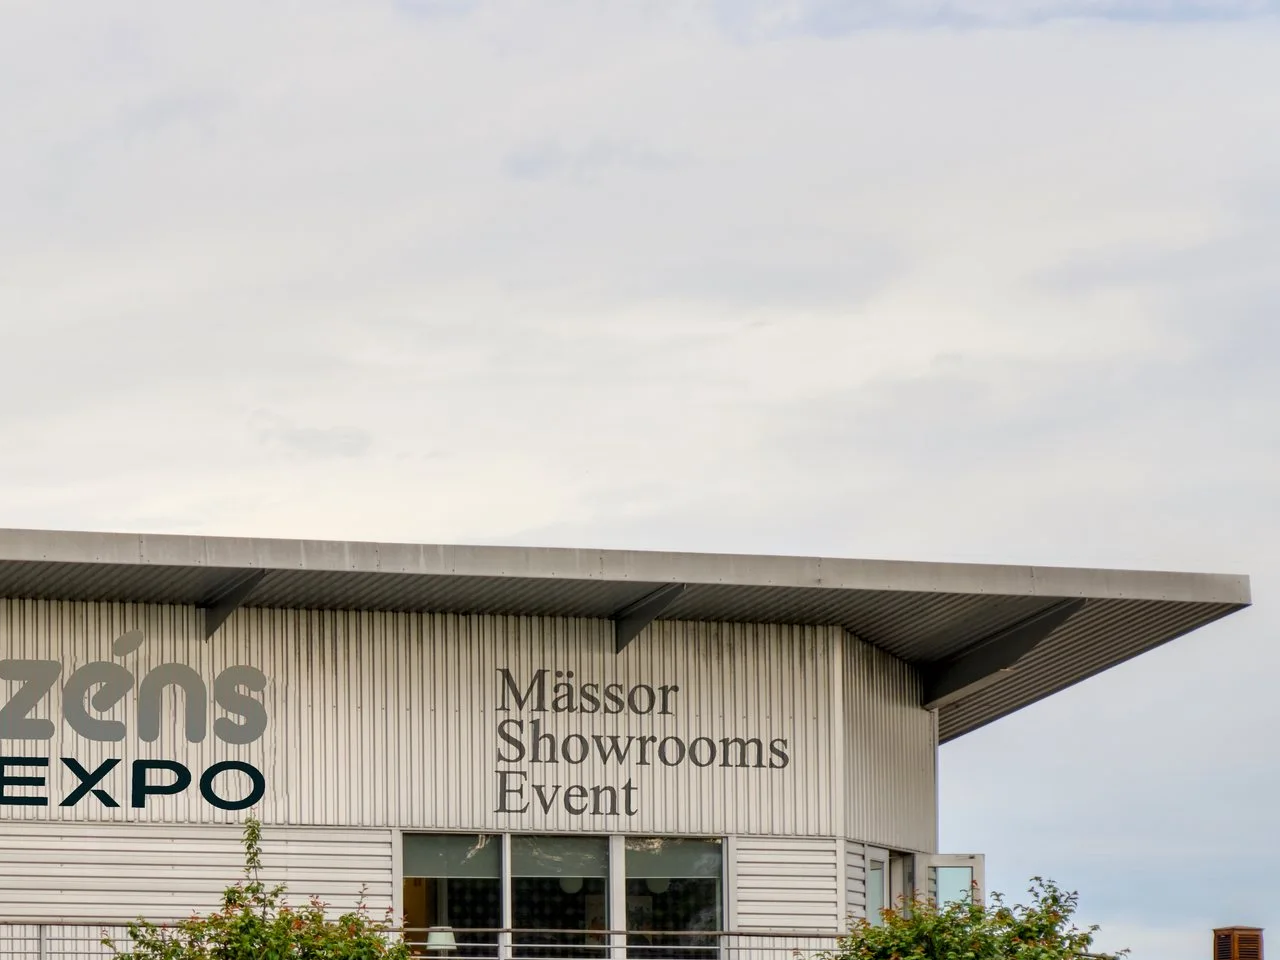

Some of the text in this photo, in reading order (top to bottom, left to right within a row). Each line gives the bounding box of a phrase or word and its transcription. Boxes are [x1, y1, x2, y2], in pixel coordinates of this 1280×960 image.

[495, 668, 679, 715] Mässor
[497, 718, 790, 769] Showrooms
[494, 770, 639, 816] Event
